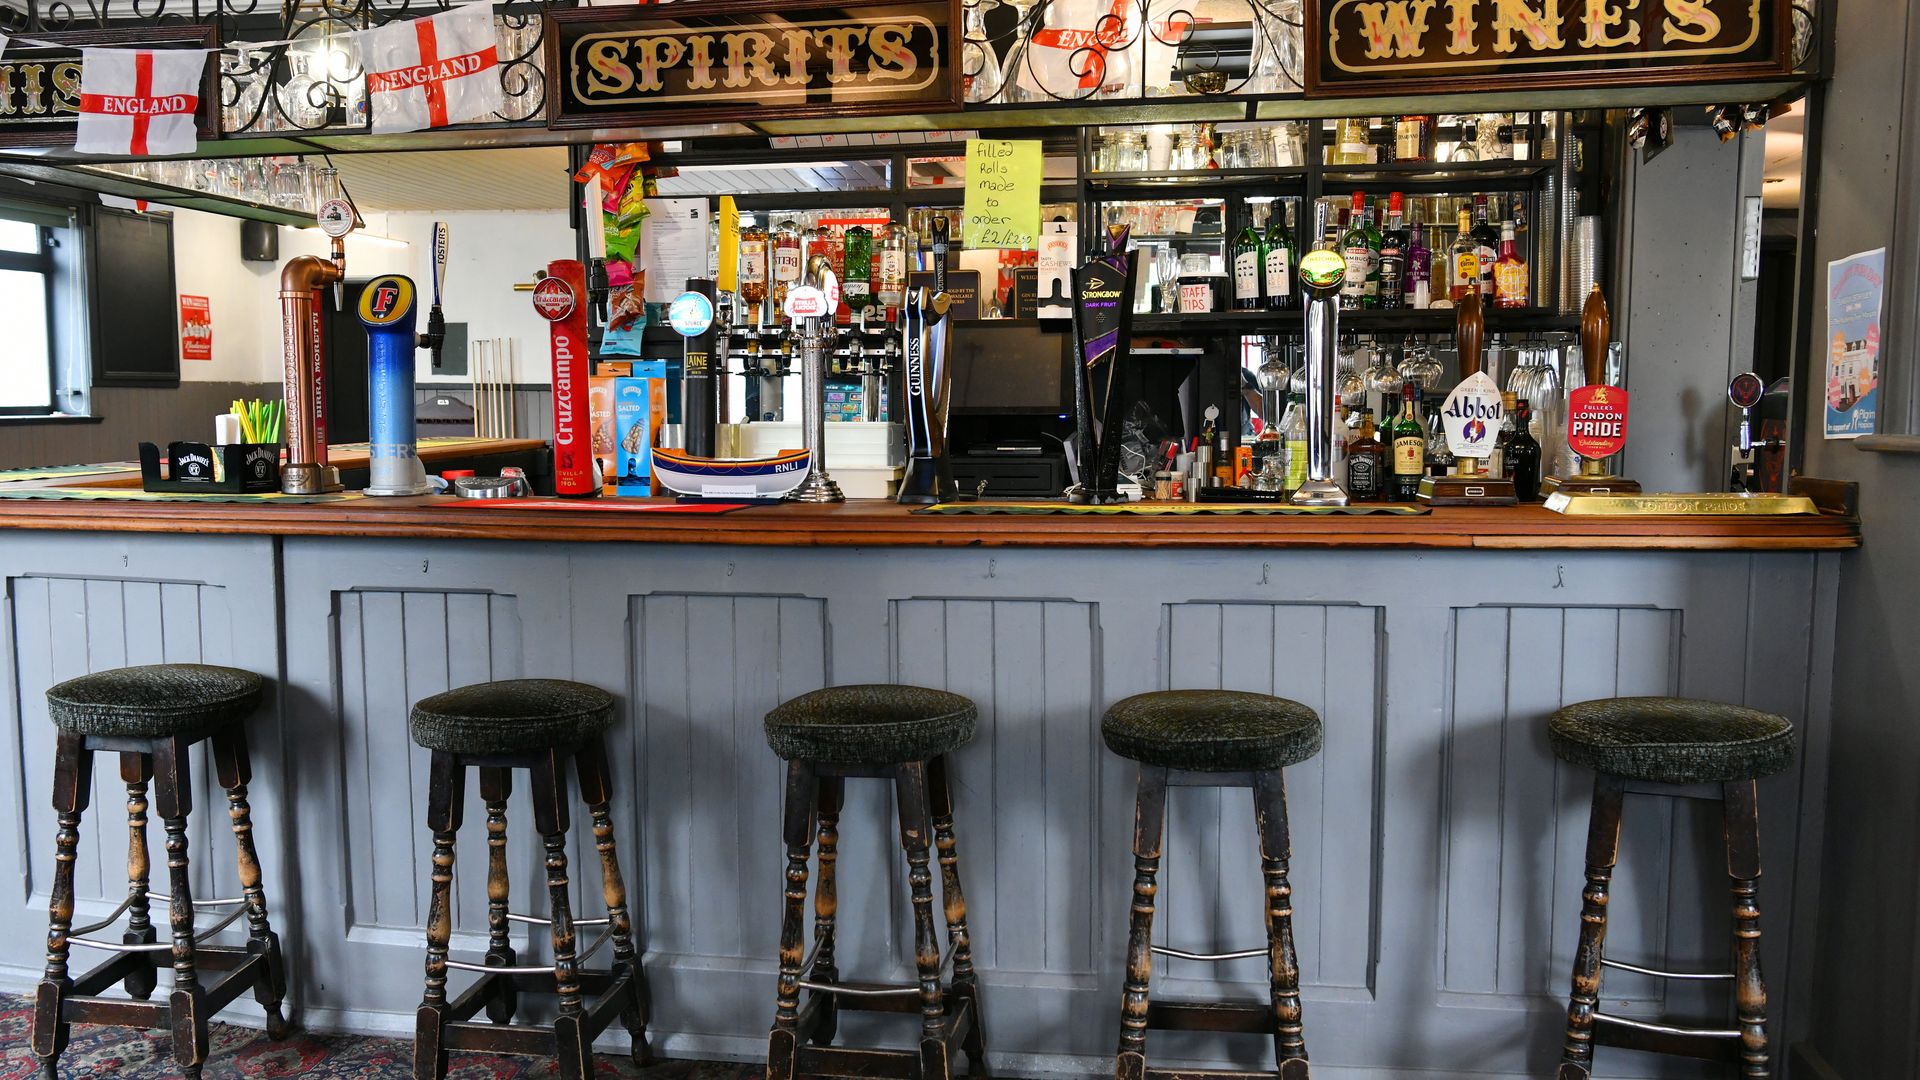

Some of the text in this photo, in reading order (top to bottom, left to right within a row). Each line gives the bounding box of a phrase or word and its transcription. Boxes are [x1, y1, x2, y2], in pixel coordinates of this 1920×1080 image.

[1357, 0, 1721, 60] WINES
[586, 24, 917, 96] SPIRITS
[389, 54, 481, 88] ENGLAND
[103, 96, 187, 114] ENGLAND
[979, 176, 1015, 191] made
[986, 197, 999, 207] to
[971, 209, 1012, 225] order
[437, 227, 446, 265] FOSTER'S
[937, 259, 945, 292] GUINNESS
[373, 287, 398, 312] F
[1082, 290, 1120, 299] STRONGBOW
[1181, 287, 1206, 299] STAFF
[1183, 299, 1205, 311] TIPS
[312, 312, 320, 374] MORETTI
[910, 337, 921, 396] GUINNESS
[556, 335, 574, 445] Cruzcampo
[1443, 395, 1502, 419] Abbot
[1573, 412, 1623, 420] LONDON
[1572, 421, 1622, 438] PRIDE
[179, 453, 209, 468] JACK DANIEL'S
[246, 451, 258, 465] JACK
[775, 461, 798, 473] RNLI
[1638, 501, 1698, 512] LONDON
